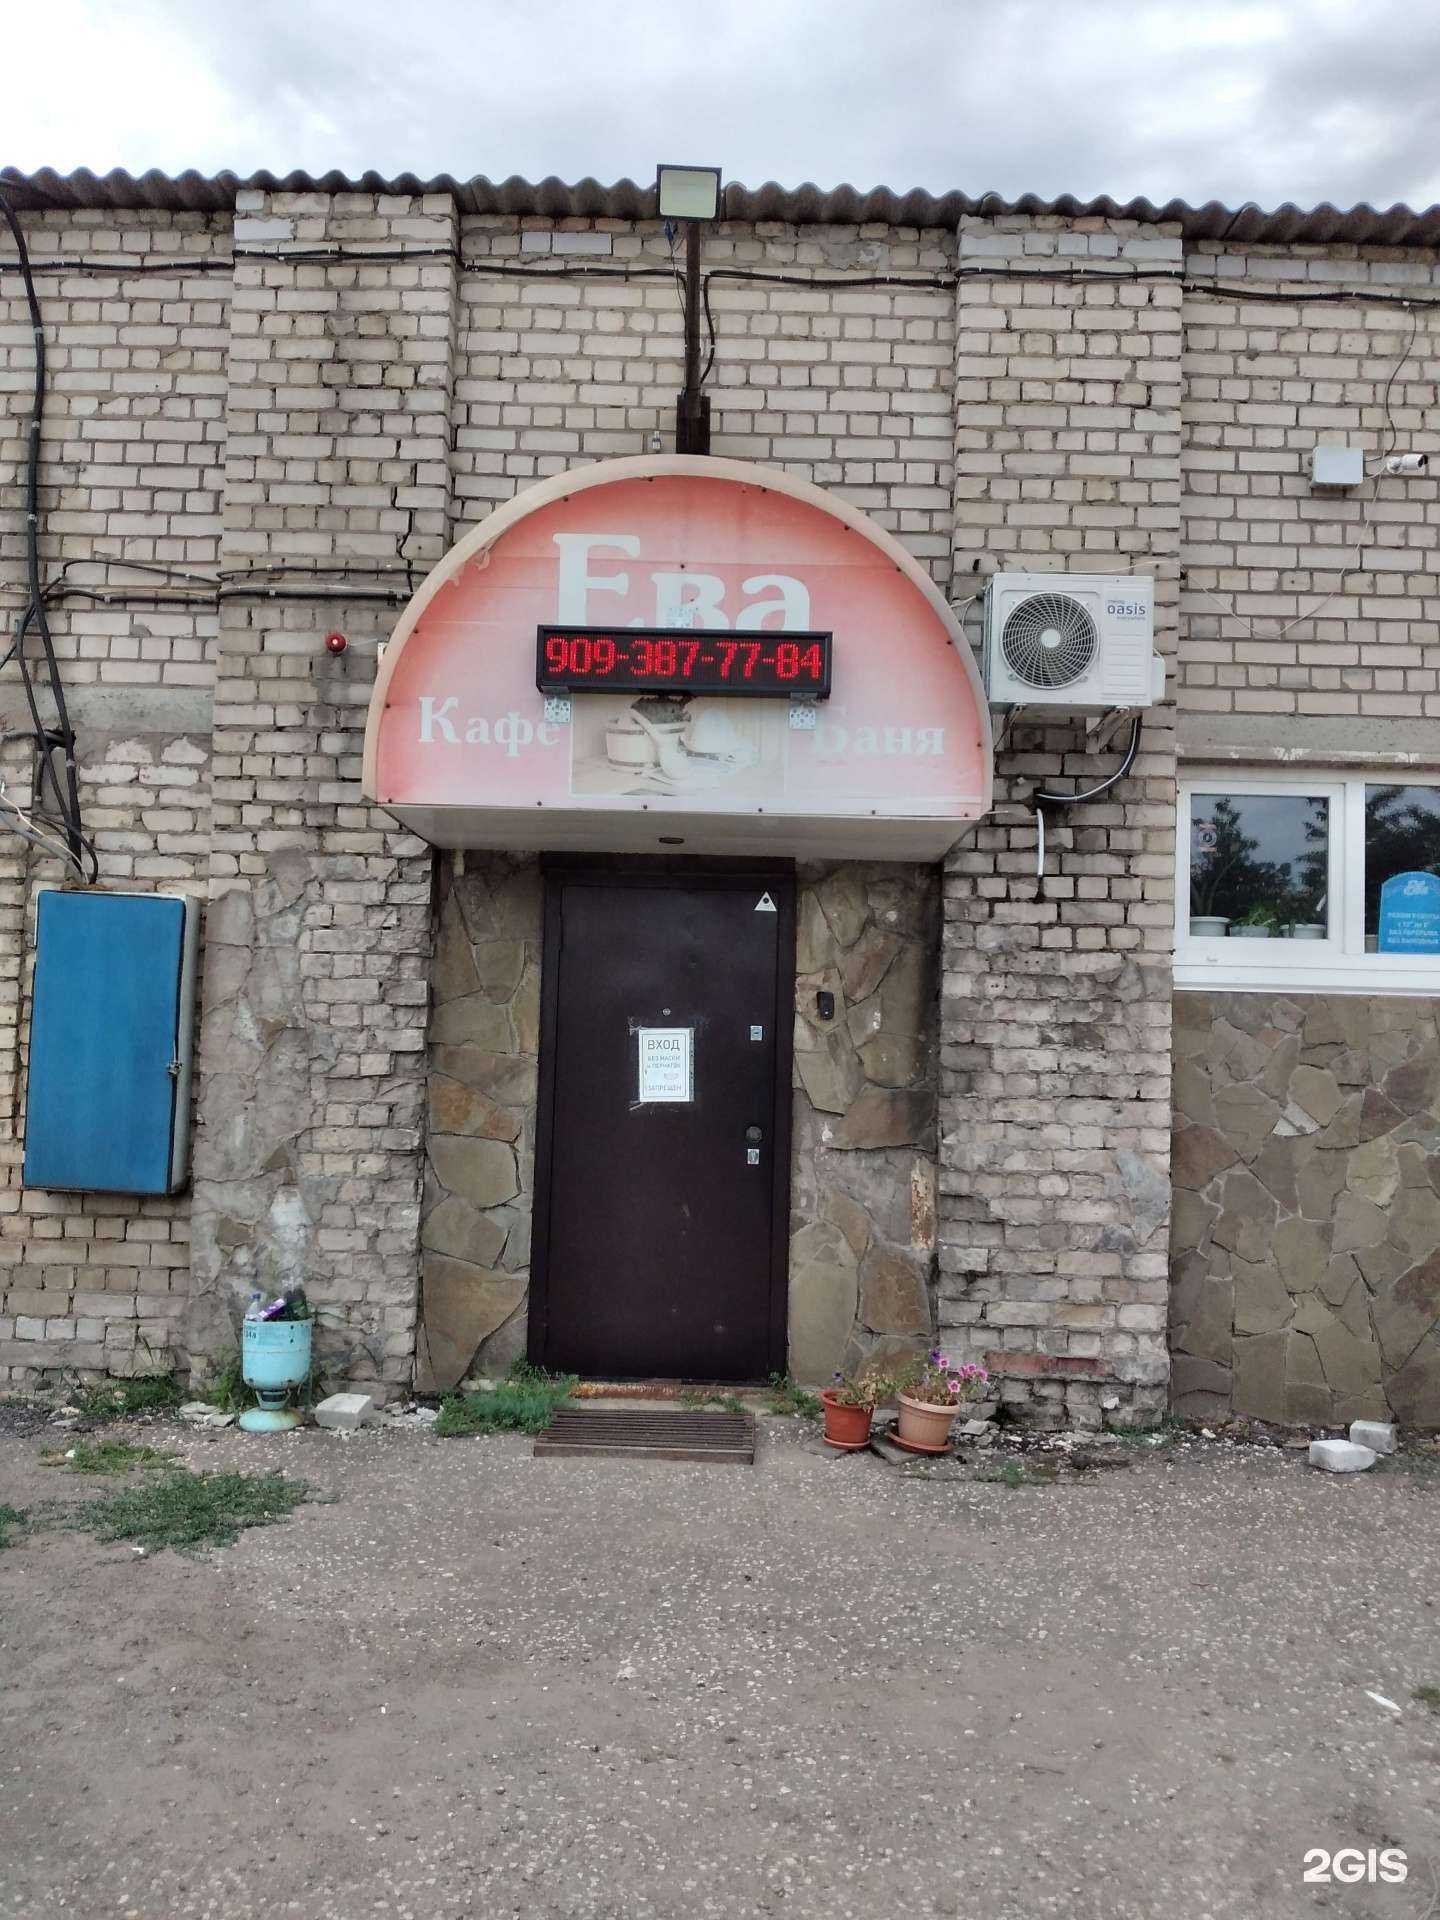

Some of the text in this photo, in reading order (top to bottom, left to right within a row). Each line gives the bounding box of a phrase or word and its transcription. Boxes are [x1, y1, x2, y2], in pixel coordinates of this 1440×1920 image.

[1107, 603, 1146, 615] oasis
[545, 635, 823, 680] 909-387-77-84
[417, 696, 945, 758] Кафе Баня
[647, 1039, 680, 1051] ВХОД
